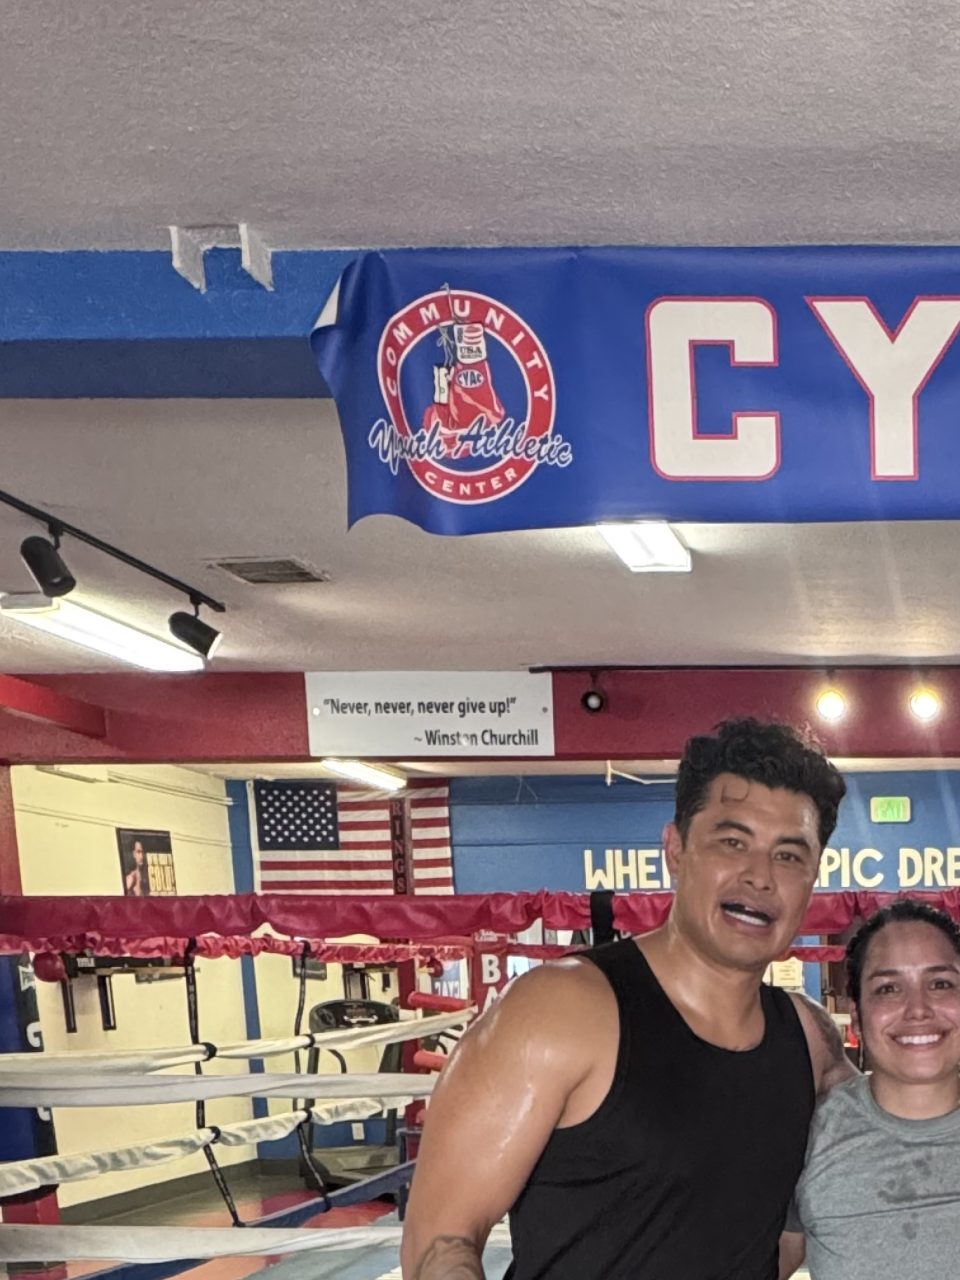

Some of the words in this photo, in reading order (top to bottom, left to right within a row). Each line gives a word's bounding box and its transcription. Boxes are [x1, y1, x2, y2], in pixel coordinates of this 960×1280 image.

[385, 299, 549, 401] COMMUNITY
[452, 413, 573, 468] Athletic
[424, 467, 518, 496] CENTER
[375, 700, 415, 716] never,
[418, 700, 453, 714] never
[458, 698, 485, 717] give
[481, 728, 539, 746] Churchill
